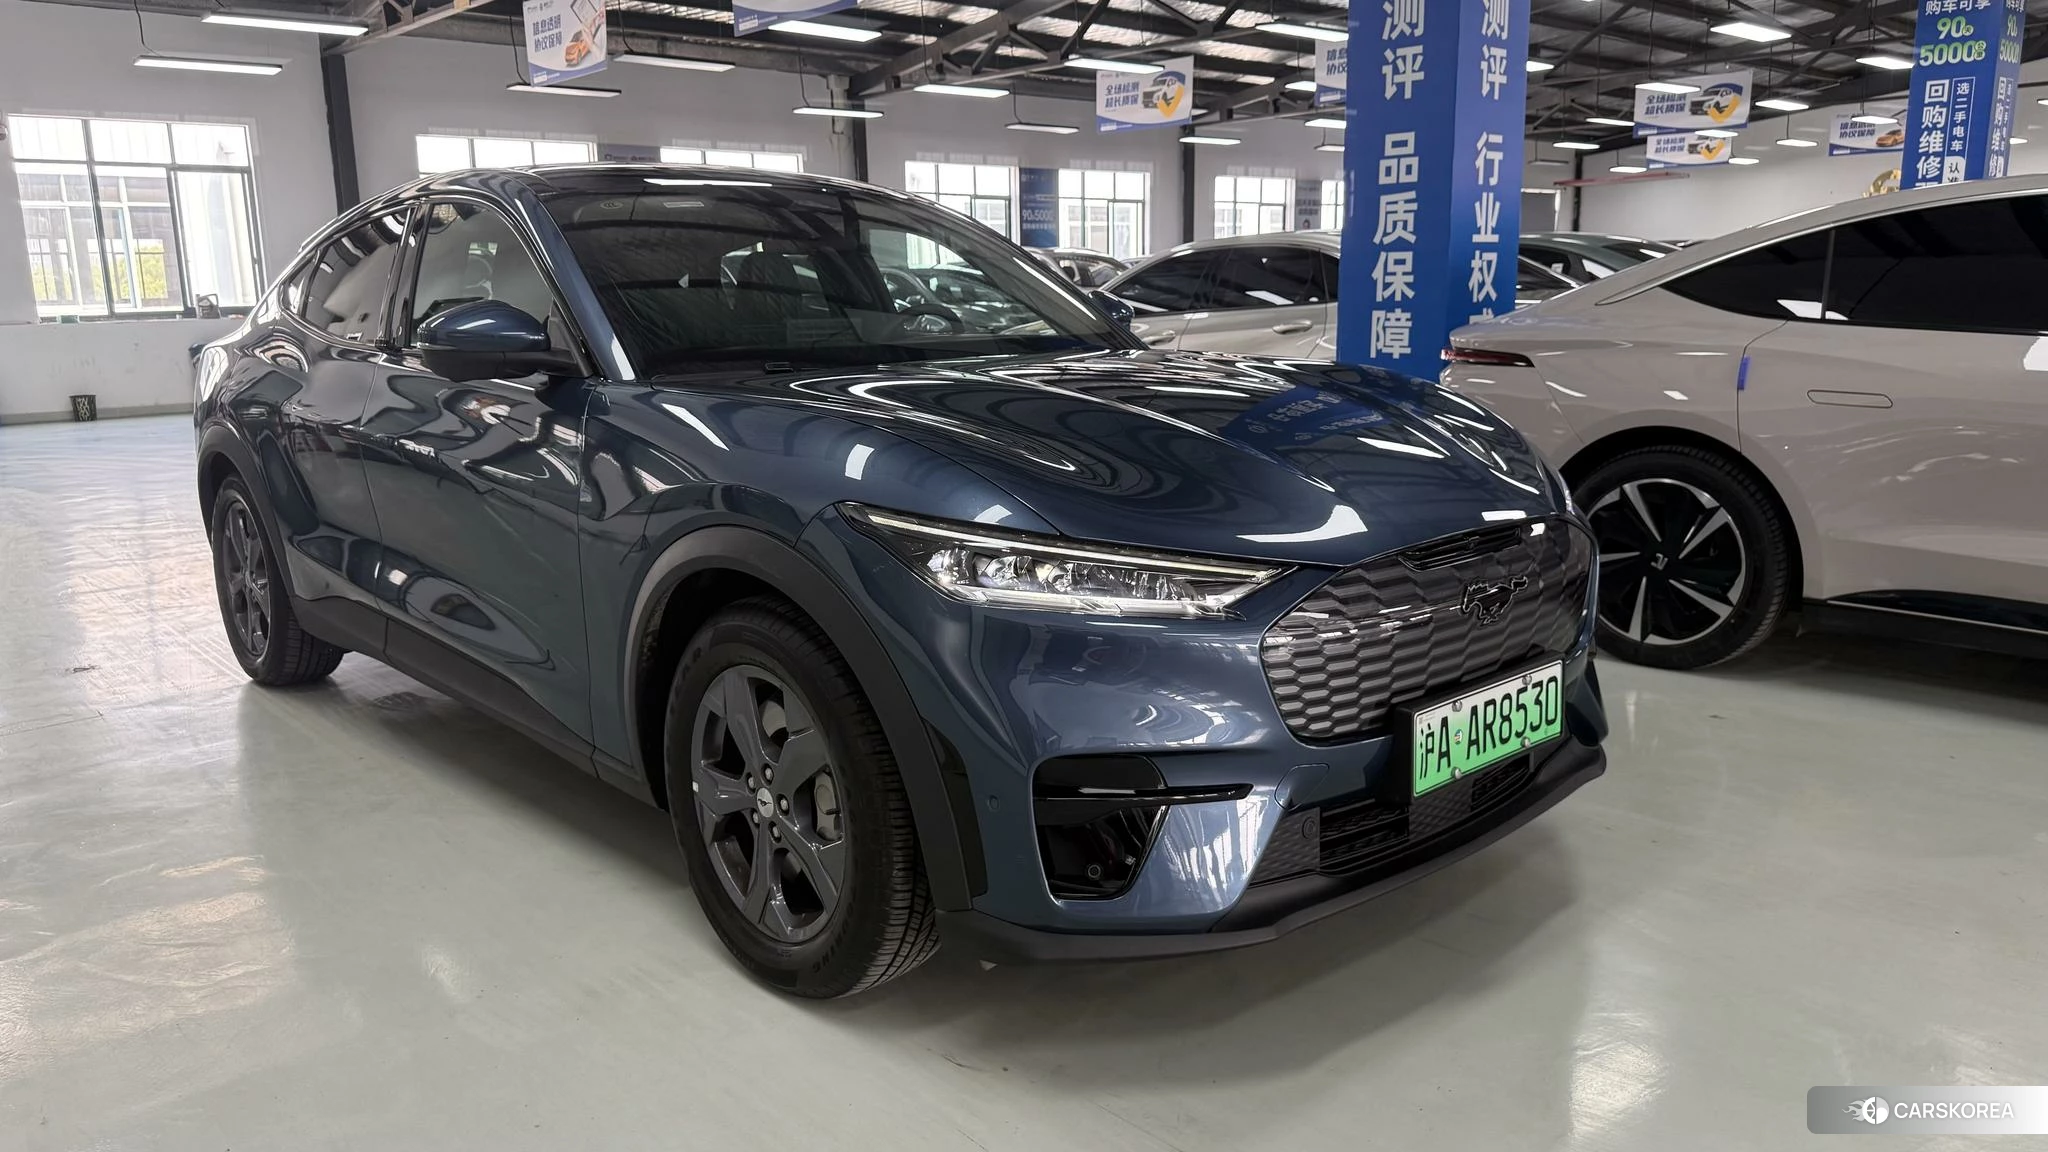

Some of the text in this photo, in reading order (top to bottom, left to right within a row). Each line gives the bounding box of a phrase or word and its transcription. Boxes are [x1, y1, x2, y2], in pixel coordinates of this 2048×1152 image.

[1915, 79, 1949, 188] 回购维修
[1950, 82, 1970, 152] 选二手电车
[1370, 131, 1419, 359] 品质保障
[1468, 131, 1504, 324] 行业权
[1466, 675, 1559, 760] AR8530
